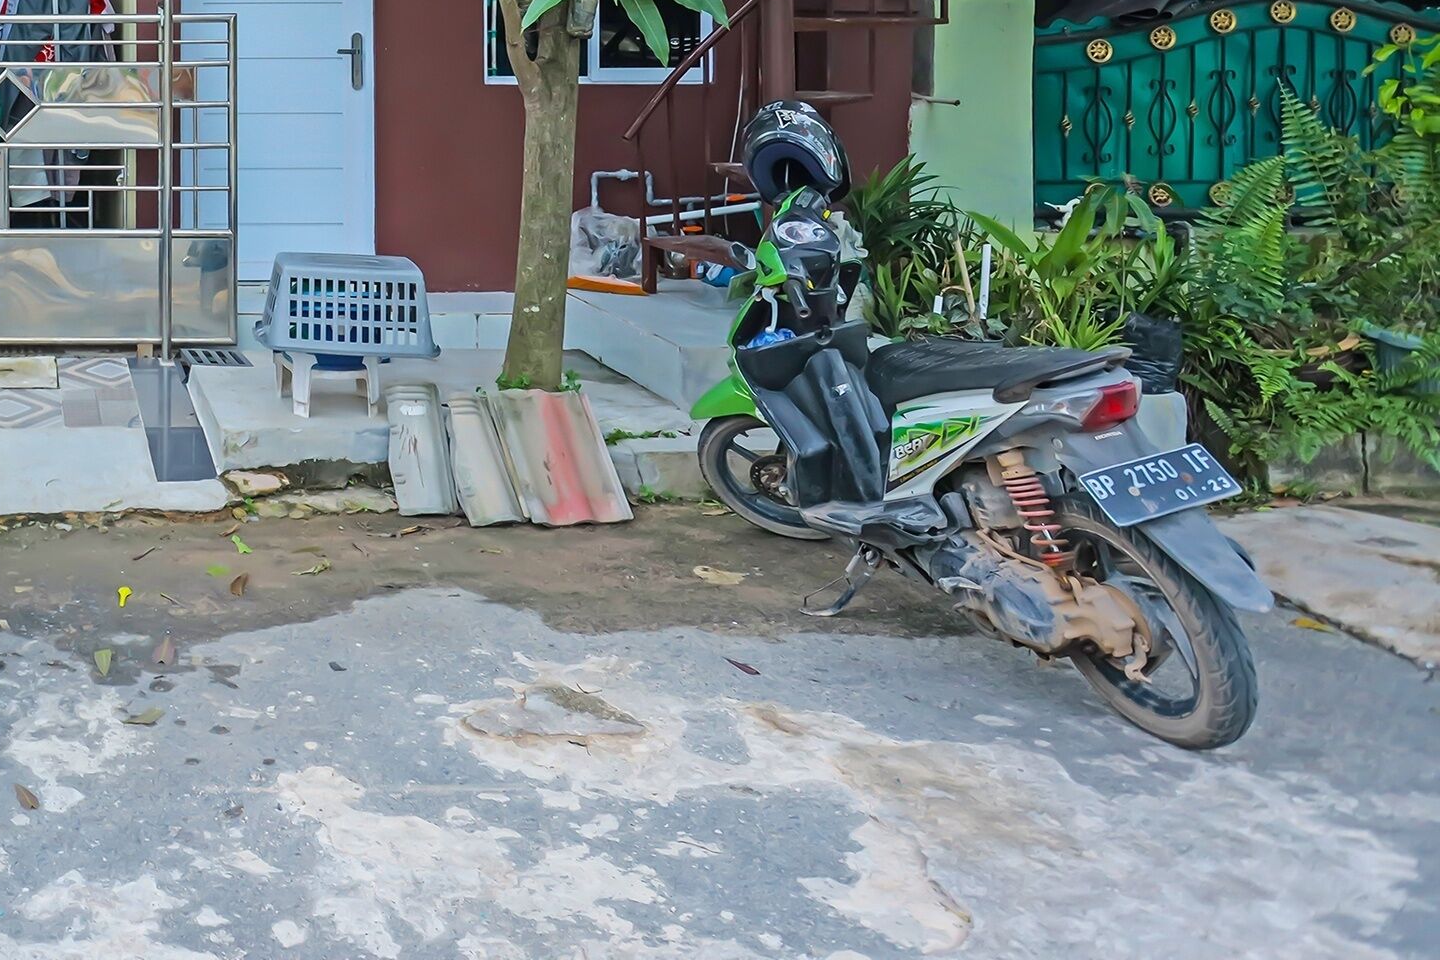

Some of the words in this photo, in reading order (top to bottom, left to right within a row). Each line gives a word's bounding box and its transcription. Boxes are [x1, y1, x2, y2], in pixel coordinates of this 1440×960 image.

[1084, 474, 1117, 501] BP
[1122, 458, 1179, 490] 2750
[1181, 448, 1211, 474] IF
